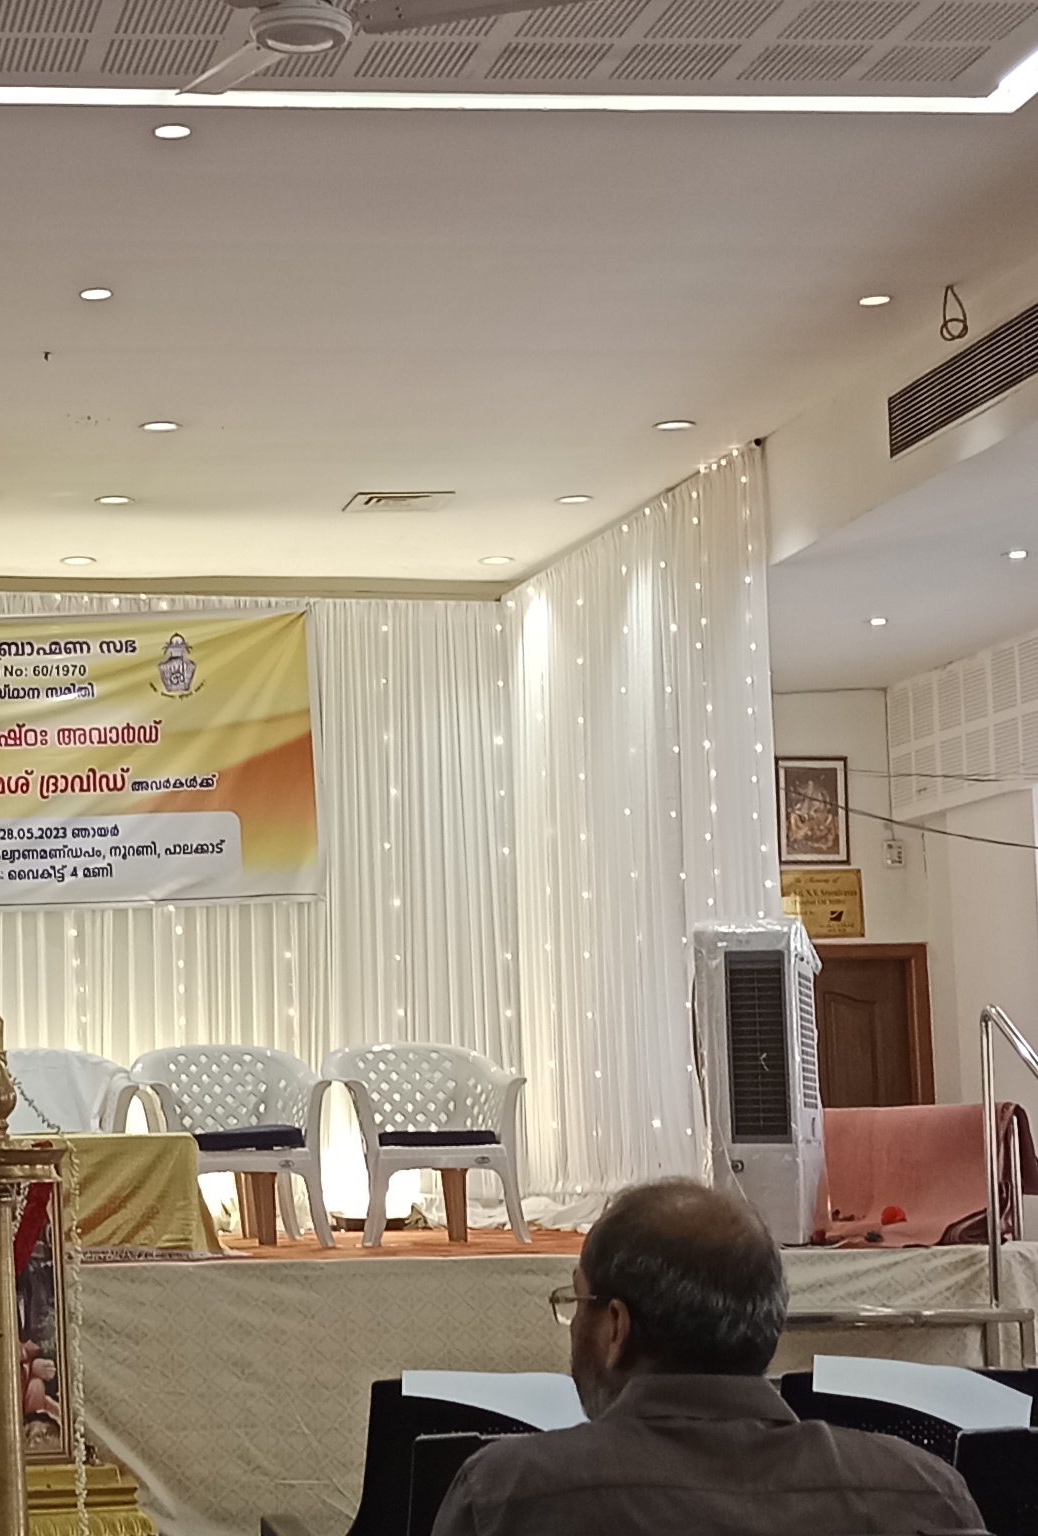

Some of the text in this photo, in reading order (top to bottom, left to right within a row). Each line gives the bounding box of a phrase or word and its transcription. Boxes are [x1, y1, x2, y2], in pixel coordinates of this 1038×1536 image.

[98, 638, 137, 654] സഭ
[3, 665, 28, 678] No:
[32, 664, 87, 678] 60/1970
[57, 719, 162, 745] അവാർഡ്
[39, 767, 130, 799] ദ്രാവിഡ്
[0, 826, 68, 841] 28.05.2023
[69, 866, 79, 879] 4
[82, 863, 113, 879] മണി
